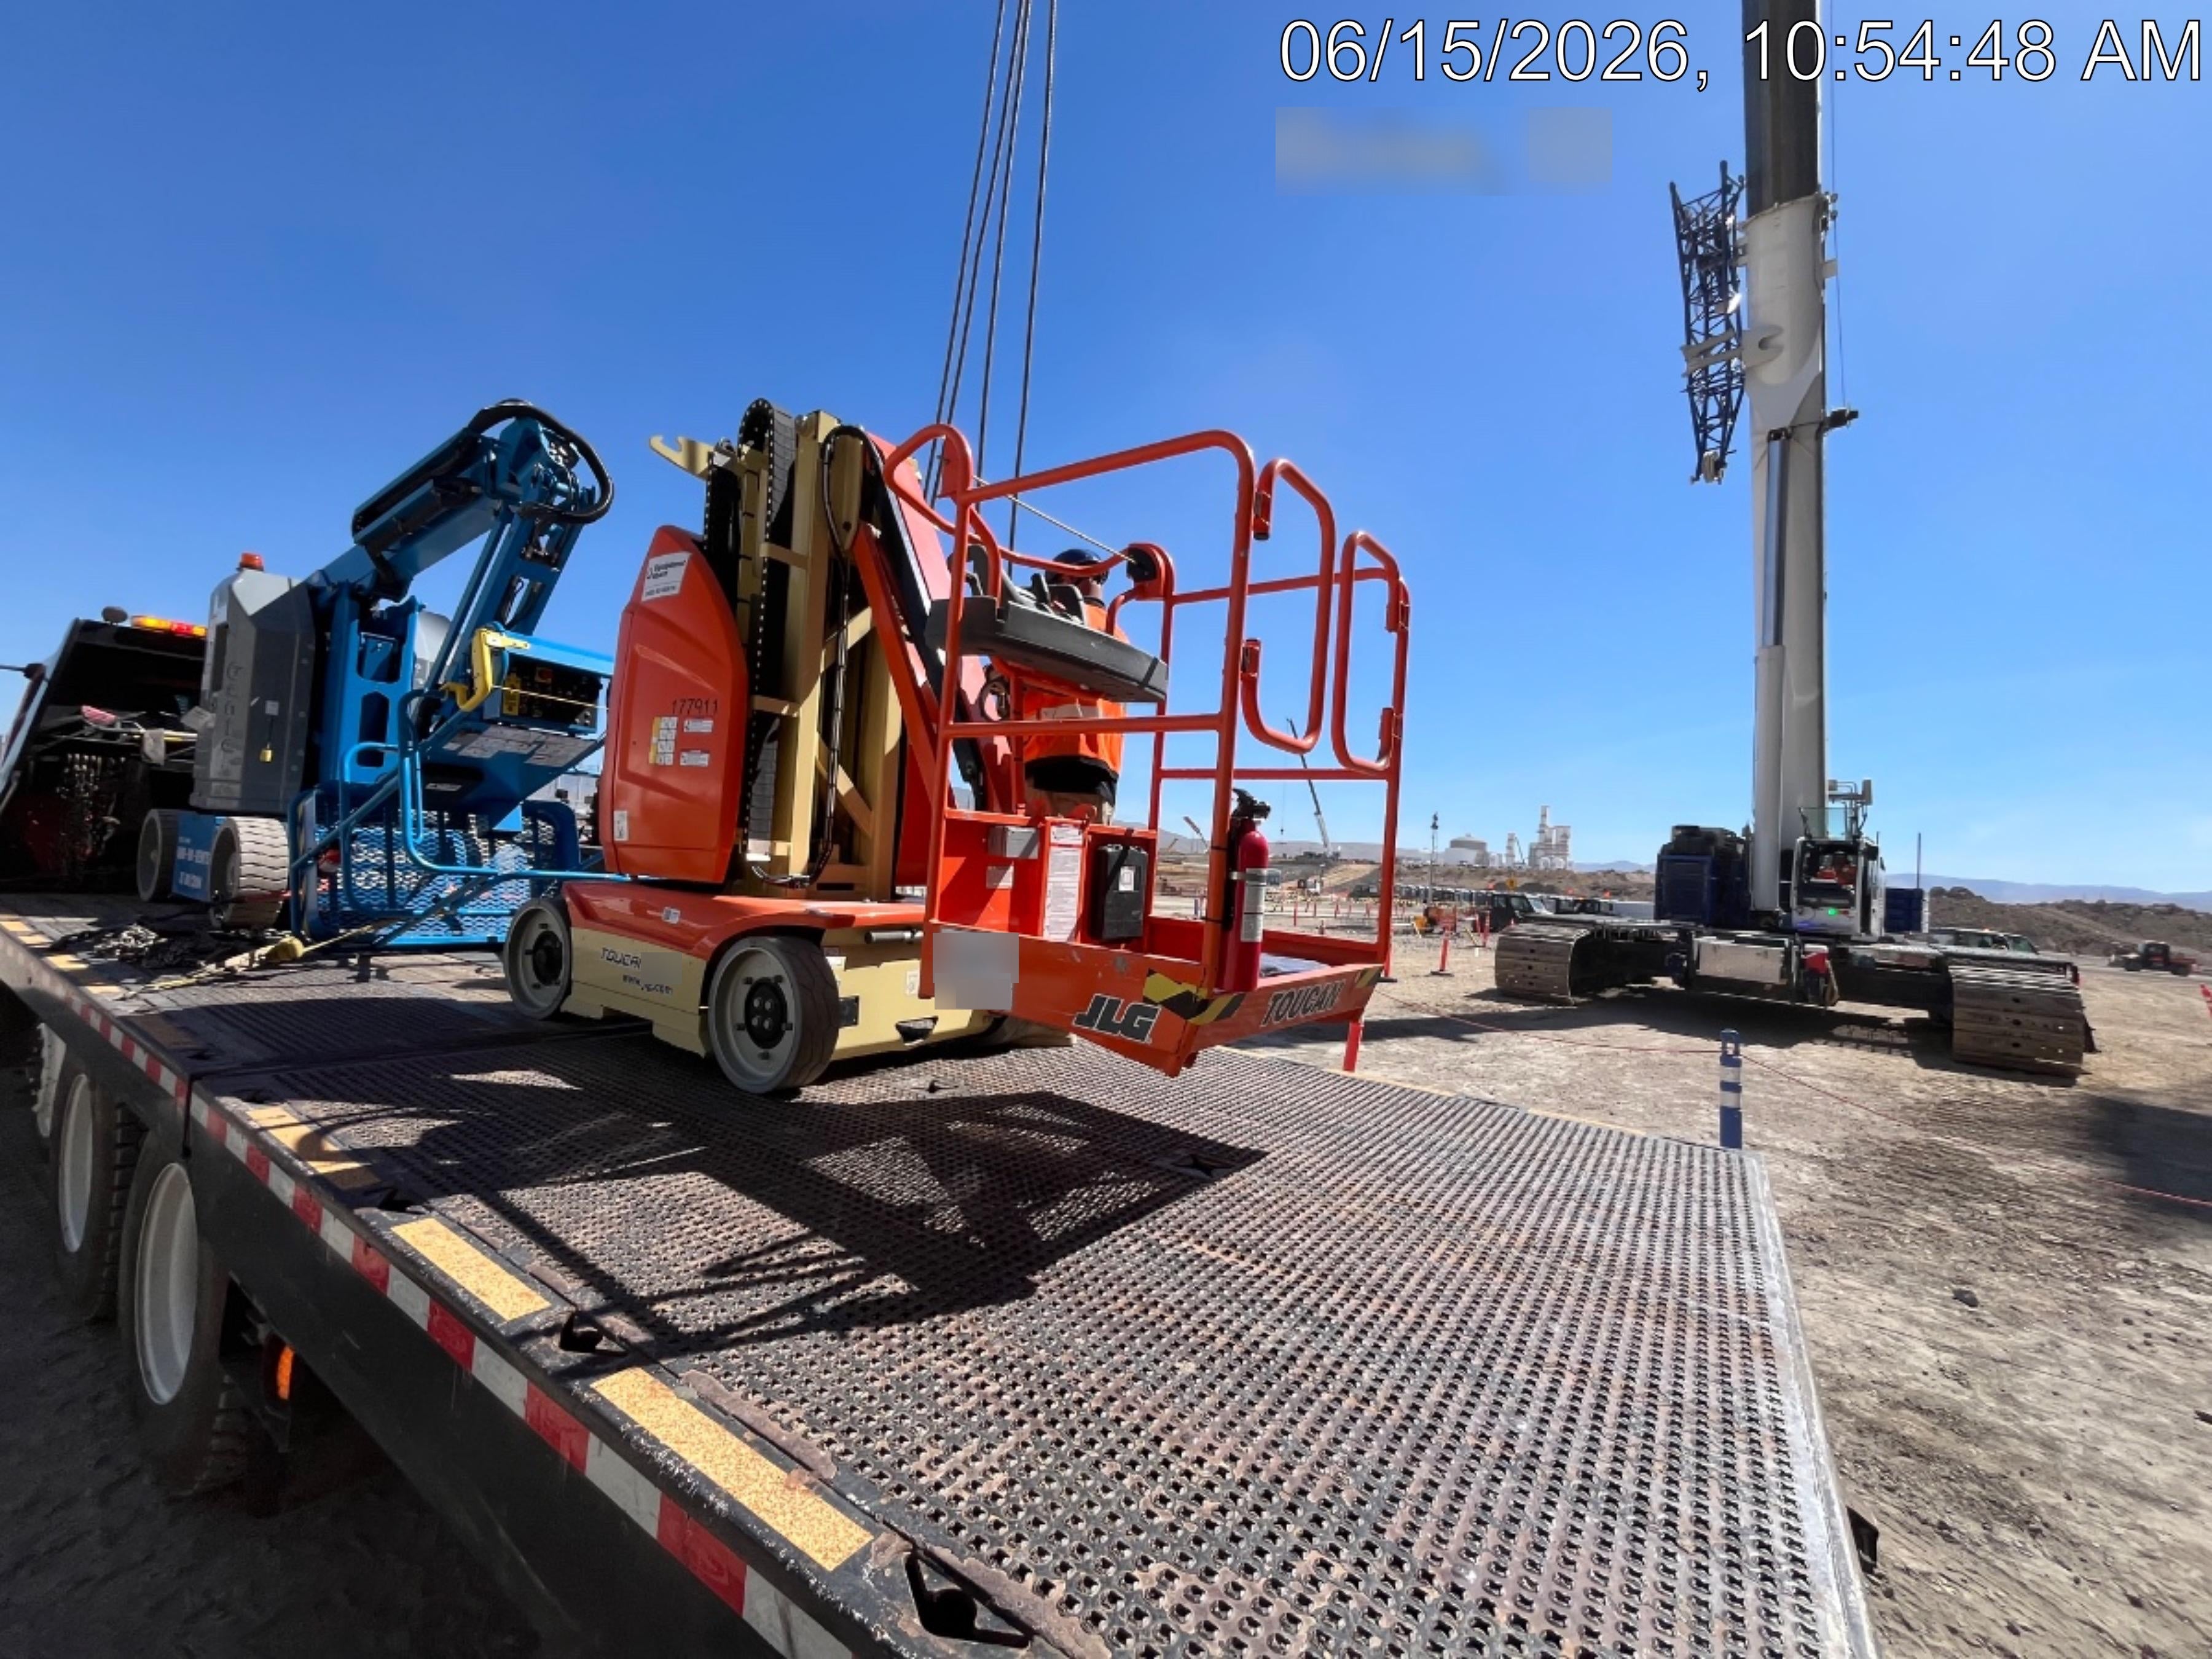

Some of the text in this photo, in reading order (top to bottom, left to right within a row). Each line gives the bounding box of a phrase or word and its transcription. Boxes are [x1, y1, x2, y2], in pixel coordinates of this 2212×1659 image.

[672, 698, 718, 715] 177911
[1072, 992, 1162, 1044] JLG
[1259, 978, 1347, 1027] TOUCAN
